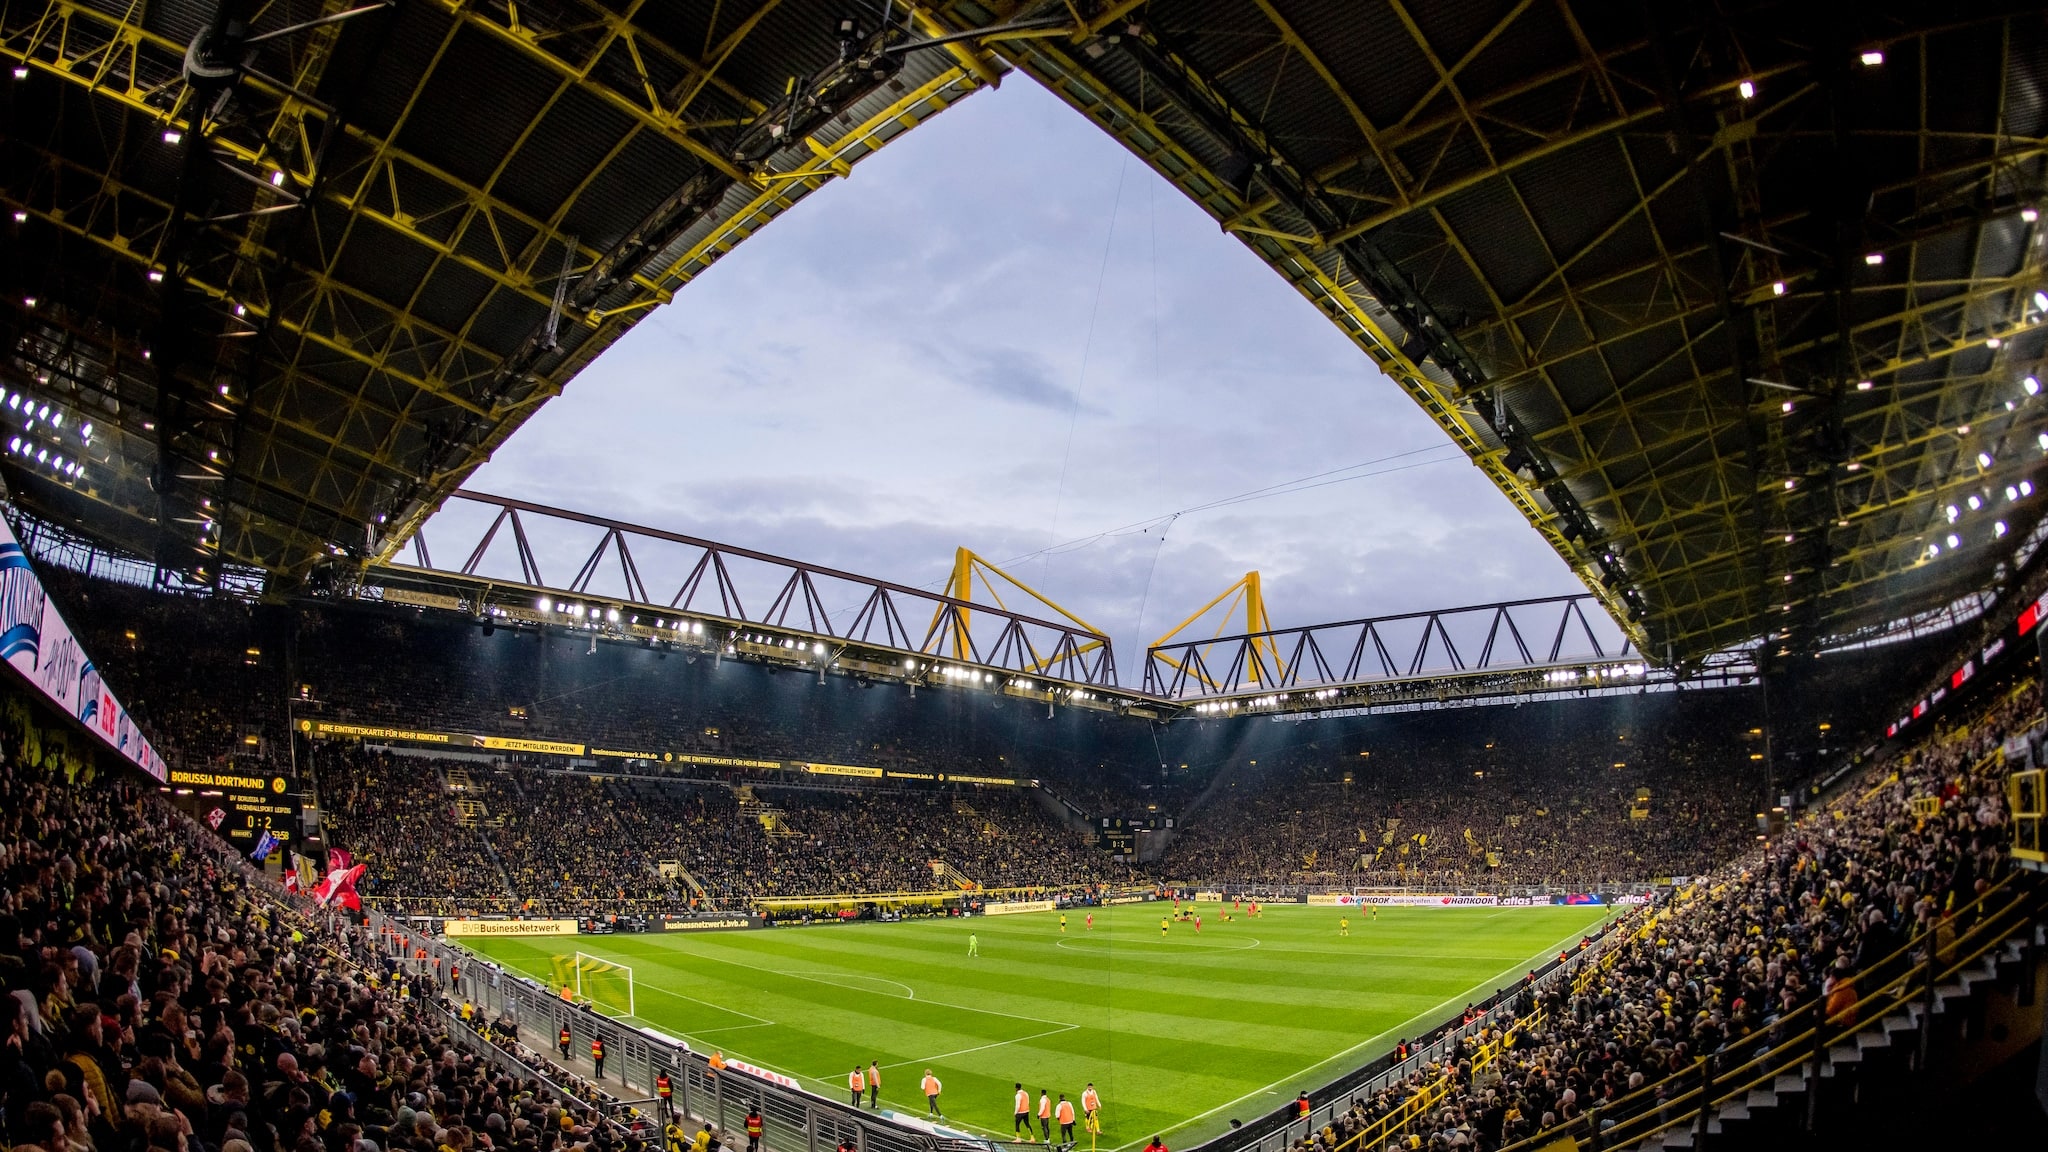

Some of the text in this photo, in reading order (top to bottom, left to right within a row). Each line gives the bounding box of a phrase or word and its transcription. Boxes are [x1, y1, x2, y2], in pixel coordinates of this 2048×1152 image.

[319, 724, 449, 743] IHRE EINTRITTSKARTE FÜR MEHR KONTAKTE
[504, 741, 576, 753] JETZT MITGLIED WERDEN!
[171, 771, 265, 789] BORUSSIA DORTMUND
[247, 815, 254, 828] 0
[265, 816, 272, 829] 2
[664, 920, 749, 930] businessnetzwerk.bvb.de
